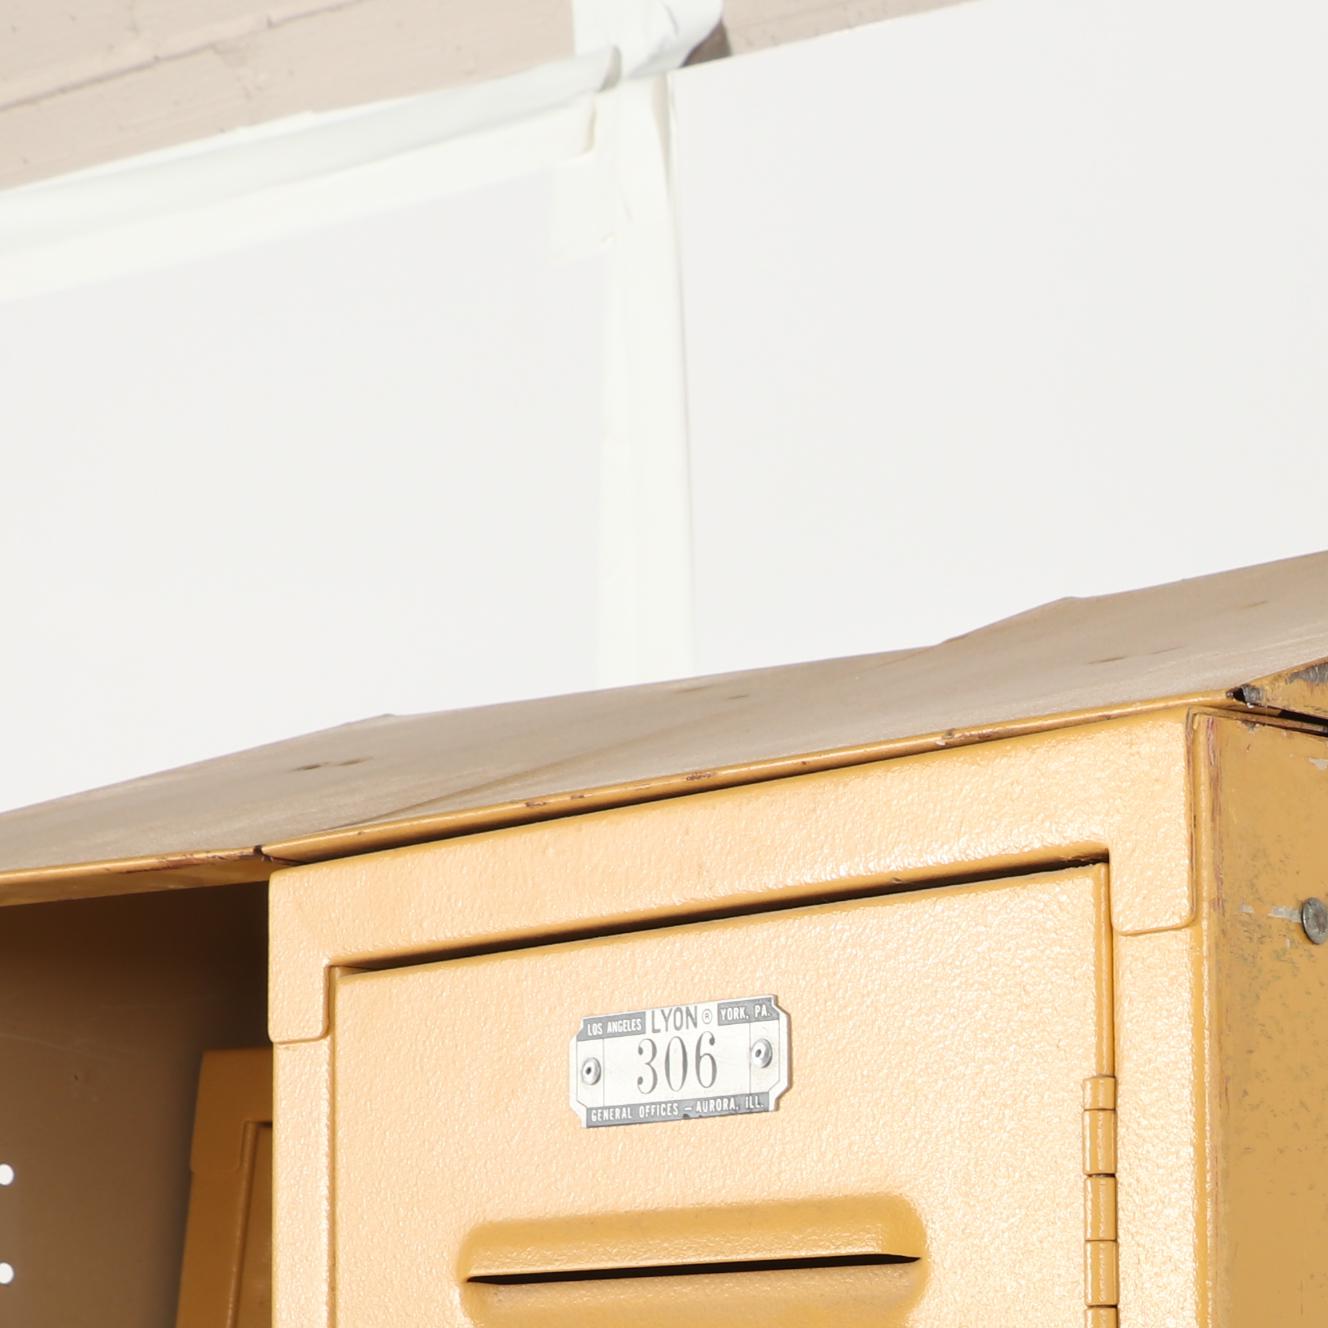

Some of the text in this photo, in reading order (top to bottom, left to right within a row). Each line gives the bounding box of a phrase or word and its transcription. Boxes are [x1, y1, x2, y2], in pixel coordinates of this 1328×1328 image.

[587, 1019, 642, 1036] LOS ANGELES
[651, 1006, 698, 1034] LYON
[637, 1031, 717, 1094] 306
[591, 1107, 633, 1122] GENERAL
[639, 1103, 679, 1118] OFFICES
